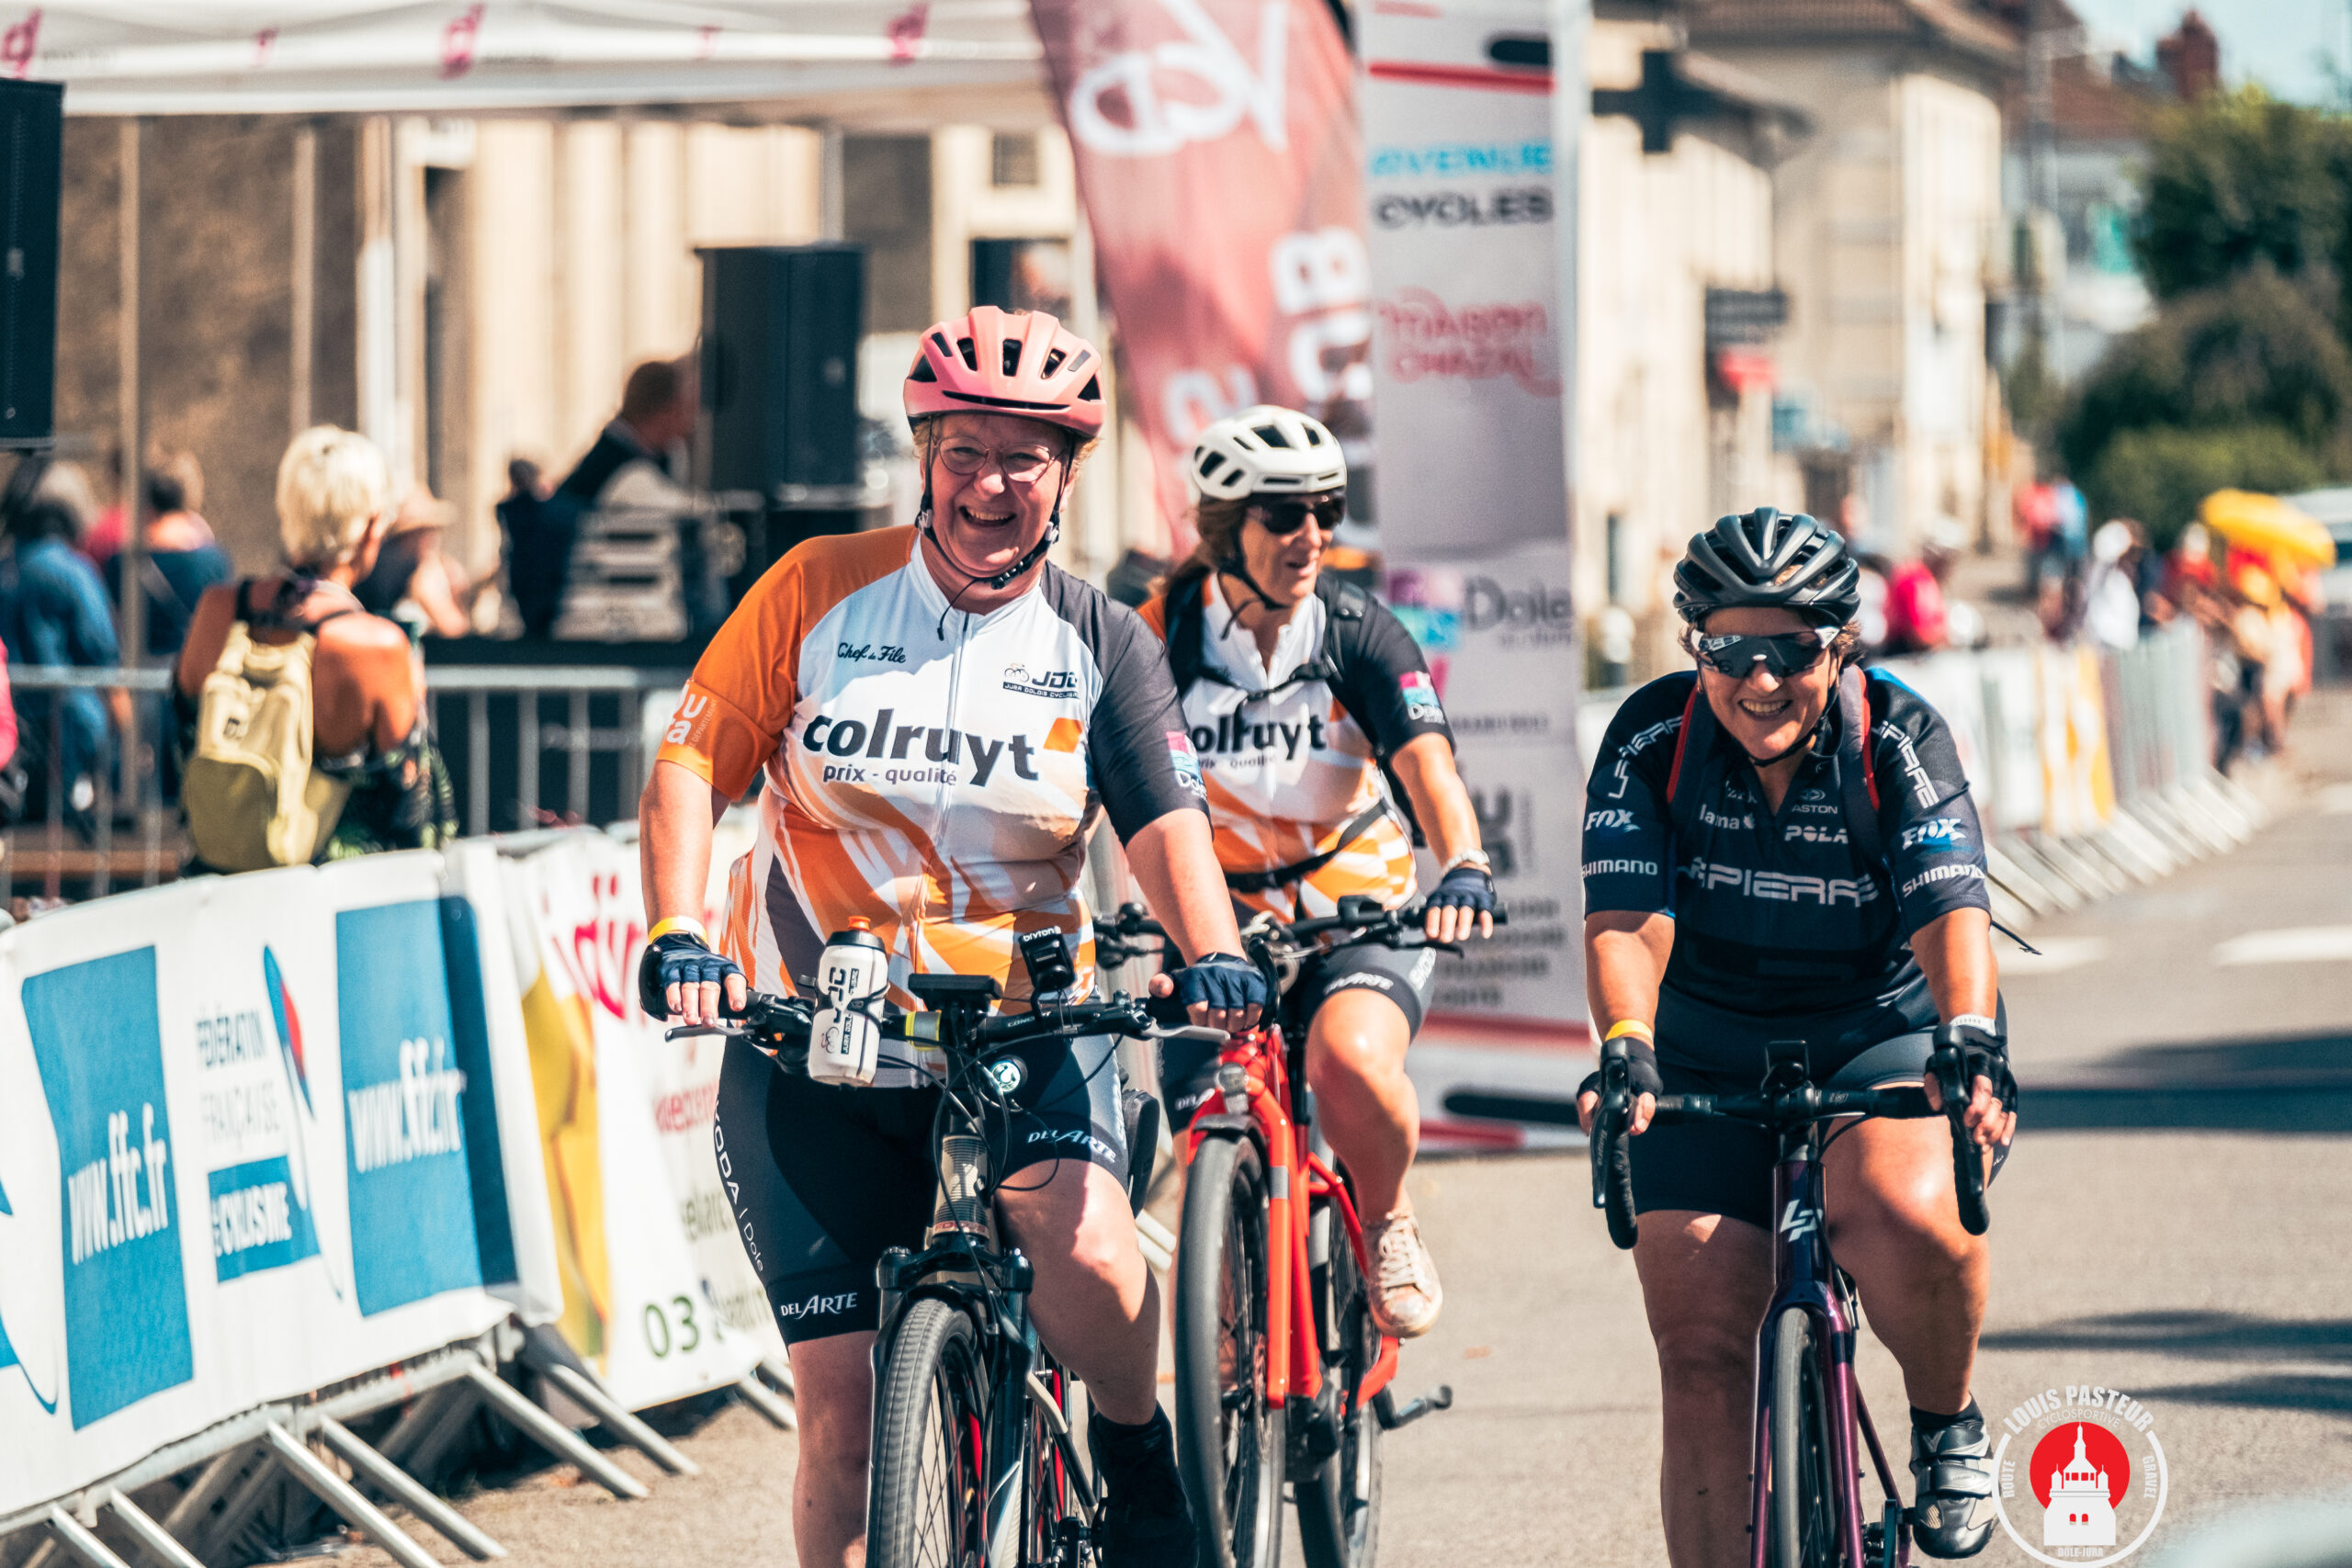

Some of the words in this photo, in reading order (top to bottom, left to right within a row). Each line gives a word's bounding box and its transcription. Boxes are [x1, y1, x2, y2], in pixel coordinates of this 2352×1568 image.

[1374, 186, 1555, 228] CYCLES
[837, 642, 871, 662] Chef
[877, 645, 907, 664] File
[1004, 682, 1023, 692] JURA
[802, 707, 1040, 788] colruyt
[1192, 714, 1327, 761] olruyt
[822, 763, 866, 784] prix
[884, 766, 957, 786] qualité
[1585, 808, 1641, 833] FOX
[1792, 805, 1838, 815] ASTON
[1784, 826, 1849, 844] POLA
[1902, 818, 1967, 852] FOX
[1581, 858, 1659, 879] SHIMANO
[1902, 863, 1985, 898] SHIMANO
[1022, 928, 1056, 942] bryton
[743, 1222, 764, 1272] Dole
[780, 1302, 802, 1317] DEL
[793, 1292, 858, 1321] ARTE
[644, 1294, 700, 1360] 03
